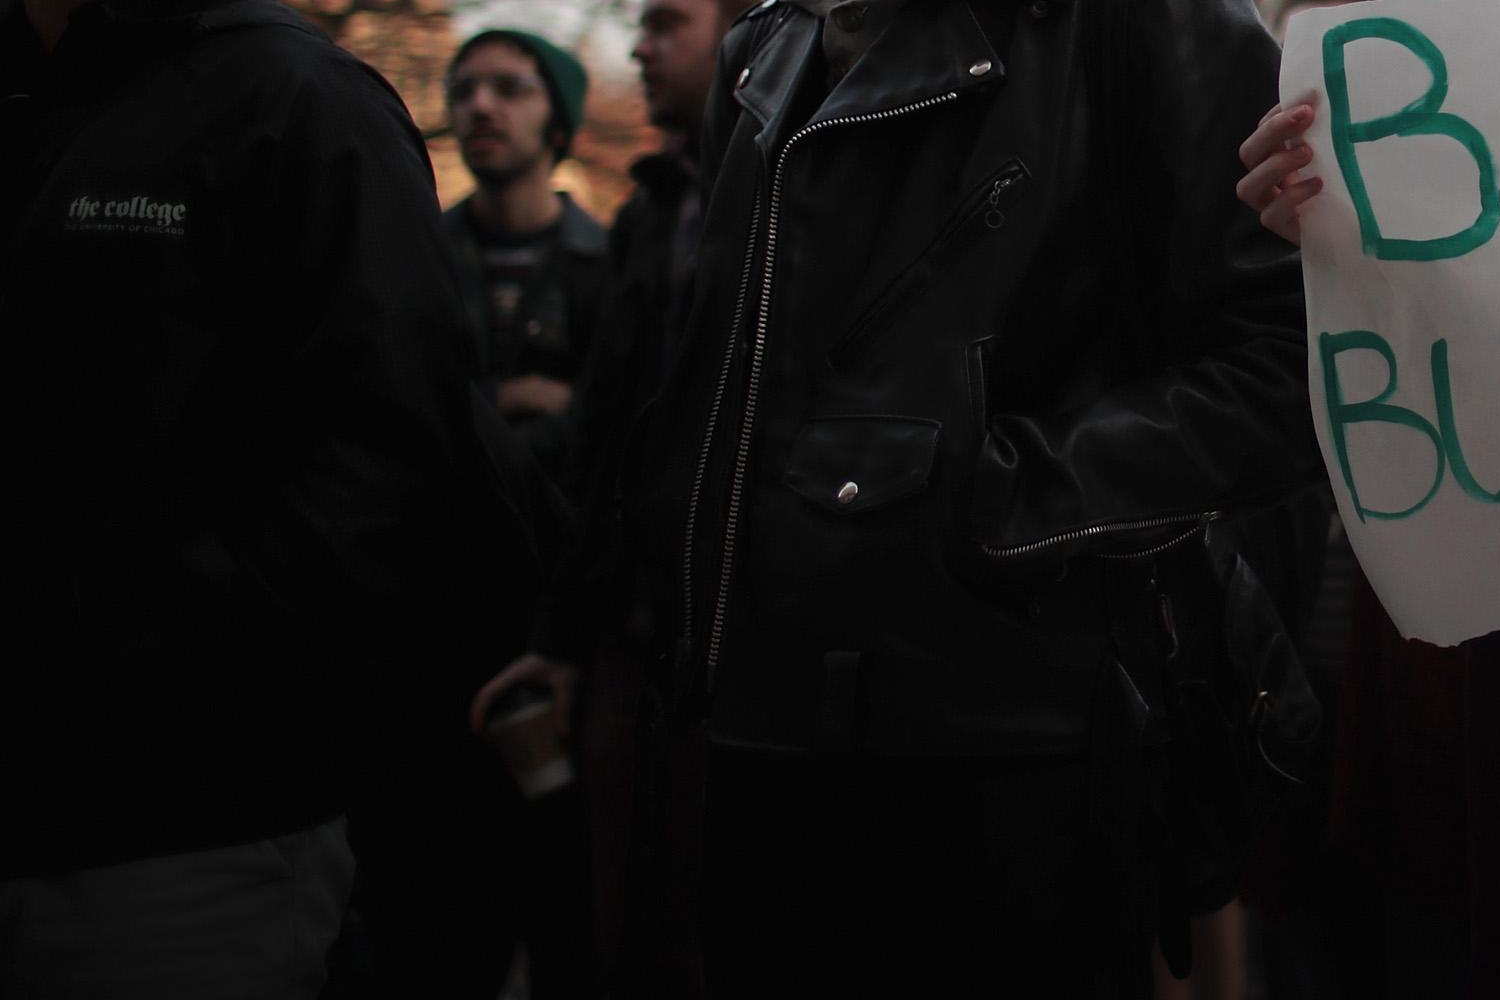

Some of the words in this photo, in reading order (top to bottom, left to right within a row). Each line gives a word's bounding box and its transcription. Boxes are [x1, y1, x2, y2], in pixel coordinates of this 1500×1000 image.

[68, 196, 101, 222] the
[105, 196, 186, 226] college
[79, 224, 125, 232] UNIVERSITY
[144, 226, 185, 235] CHICAGO
